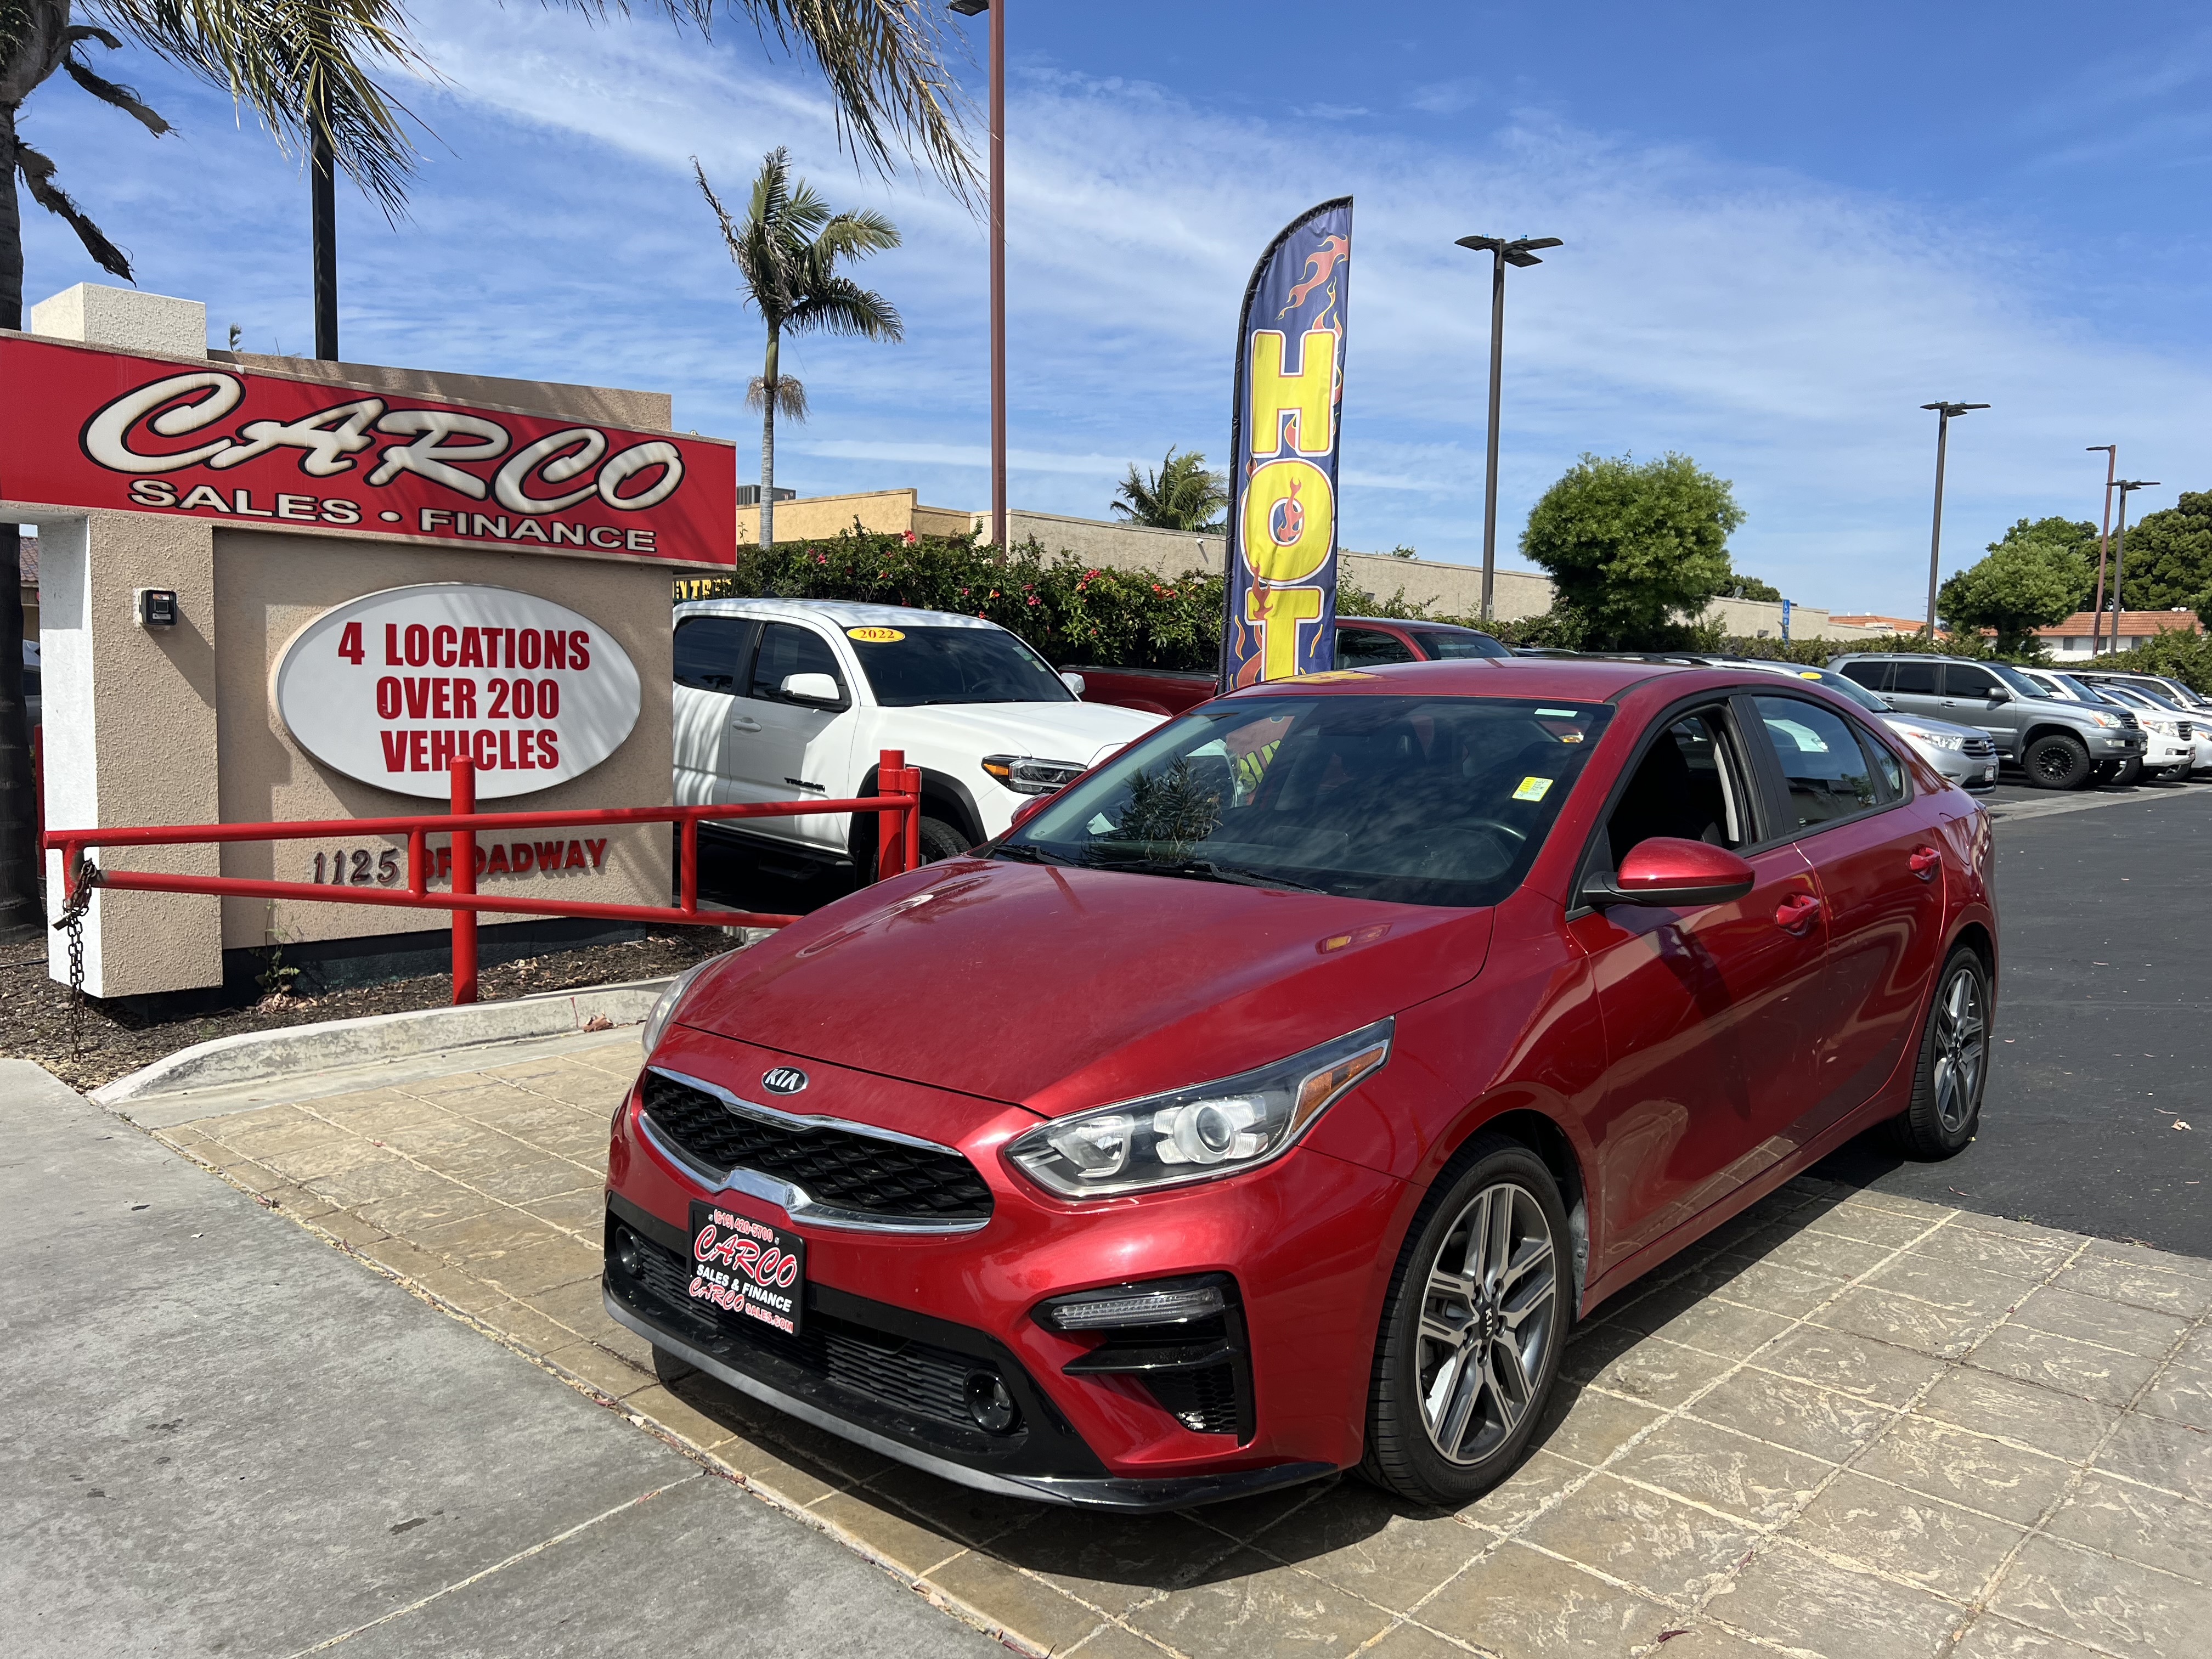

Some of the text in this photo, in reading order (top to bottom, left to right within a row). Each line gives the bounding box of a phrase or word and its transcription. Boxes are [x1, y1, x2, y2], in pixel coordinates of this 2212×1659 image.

[78, 370, 685, 515] CARCO
[128, 479, 657, 552] SALES FINANCE
[1240, 329, 1338, 682] HOT
[337, 622, 590, 670] 4 LOCATIONS
[859, 630, 894, 639] 2022
[376, 676, 559, 719] OVER 200
[380, 729, 558, 772] VEHICLES
[313, 848, 400, 884] 1125
[765, 1069, 799, 1090] KIA
[714, 1209, 734, 1230] (619)
[694, 1224, 797, 1288] CARCO
[689, 1277, 793, 1334] CARCO SALES.COM
[696, 1264, 792, 1312] SALES & FINANCE
